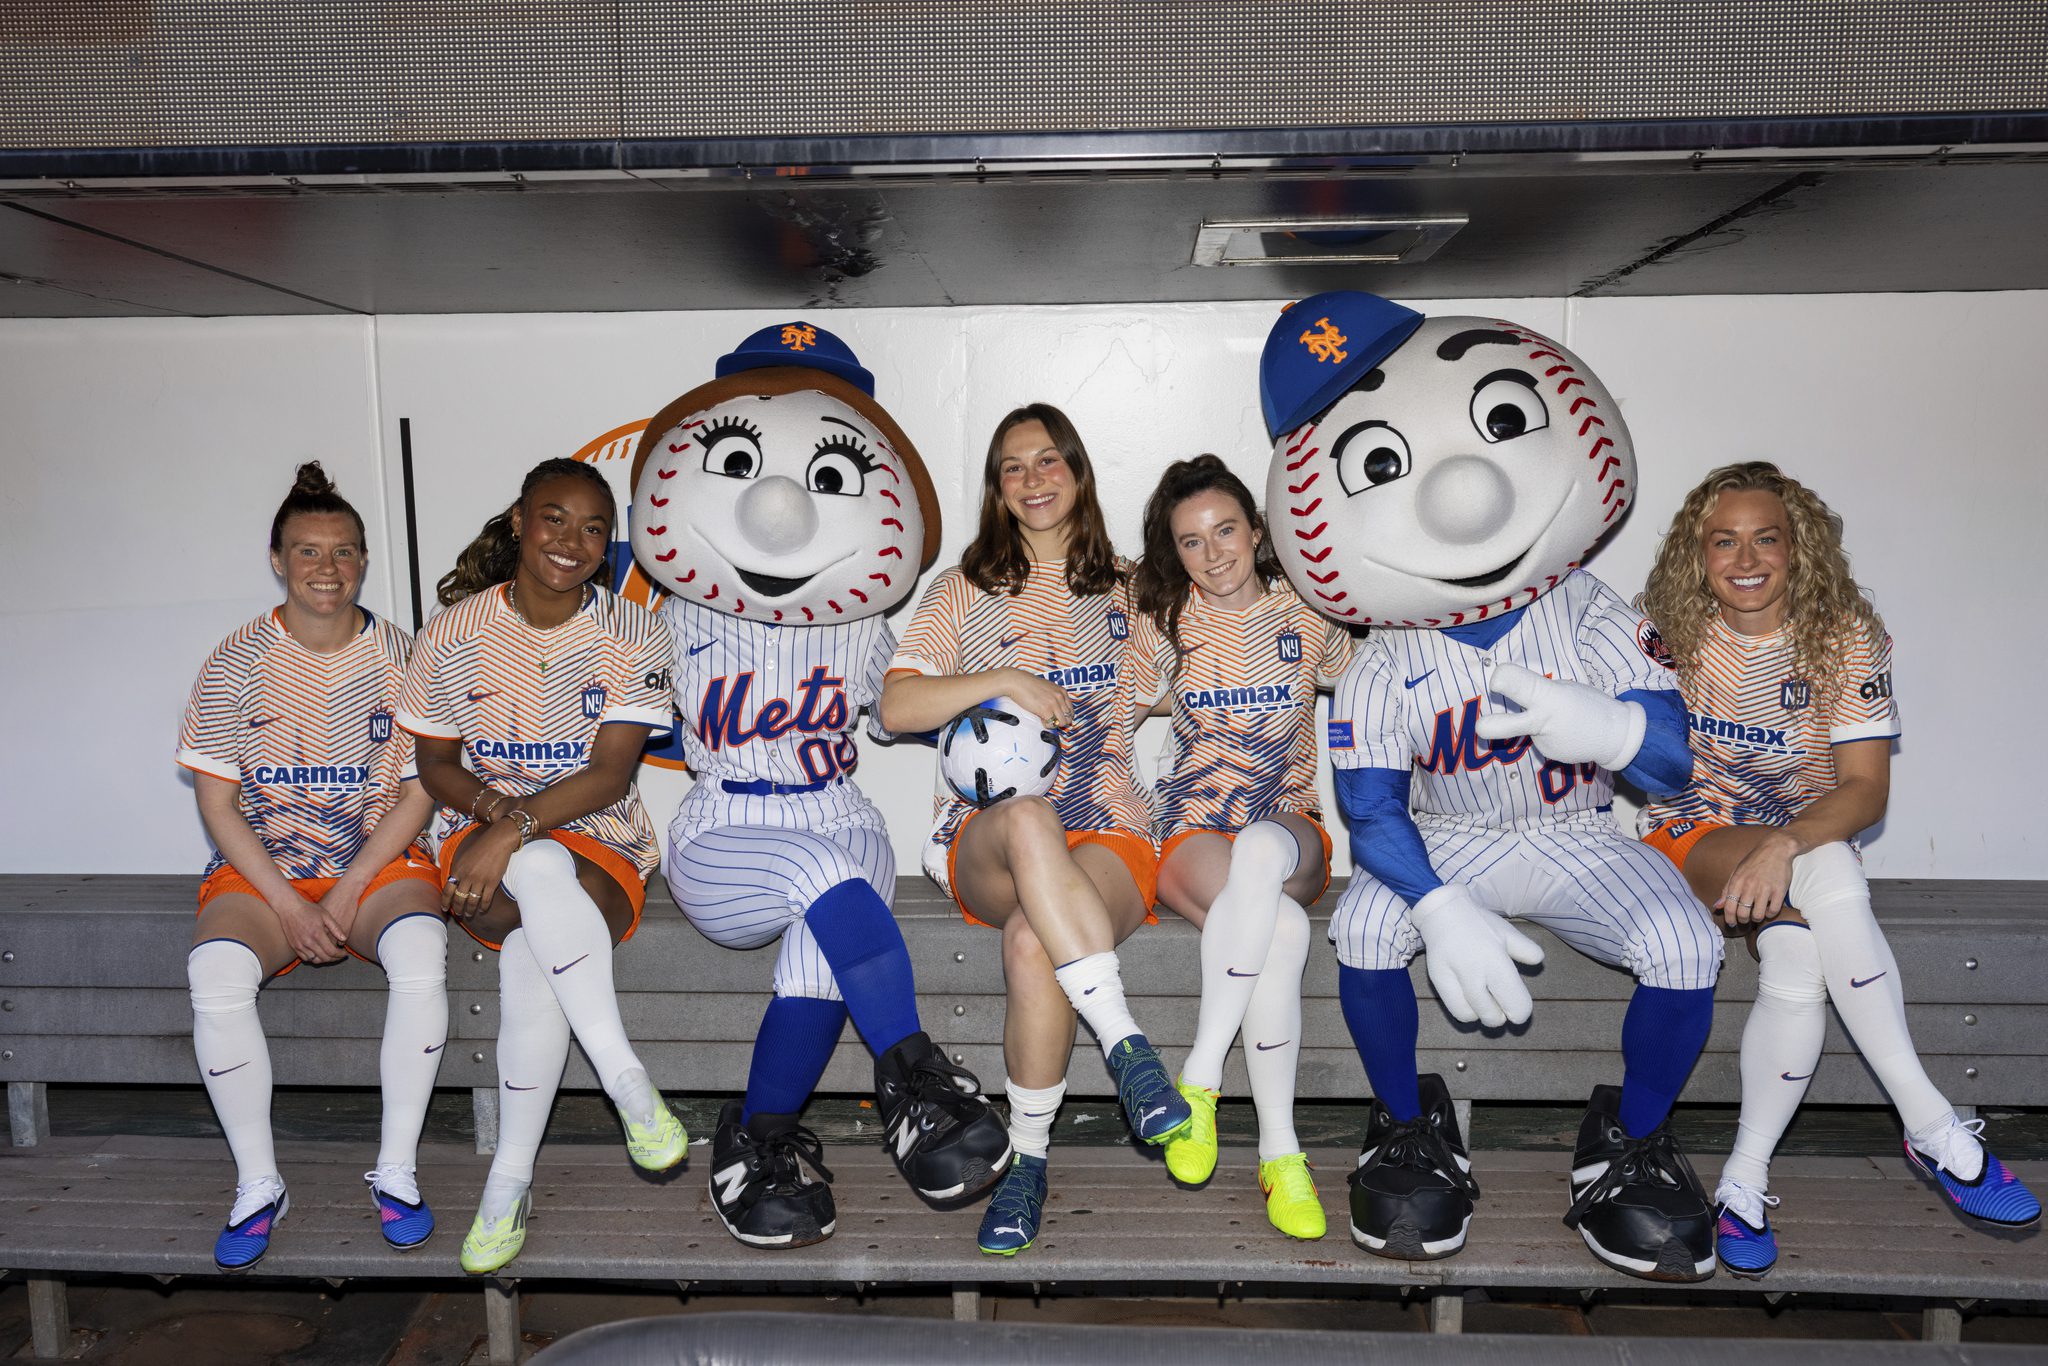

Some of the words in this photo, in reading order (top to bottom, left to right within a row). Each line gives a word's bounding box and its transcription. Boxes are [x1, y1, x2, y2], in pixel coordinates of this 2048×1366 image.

[1110, 616, 1126, 636] NY
[1281, 638, 1299, 659] NY
[1037, 663, 1116, 687] Rmax
[585, 693, 603, 714] NY
[699, 665, 850, 754] Mets
[372, 718, 389, 738] NY
[1688, 712, 1787, 747] ARmax
